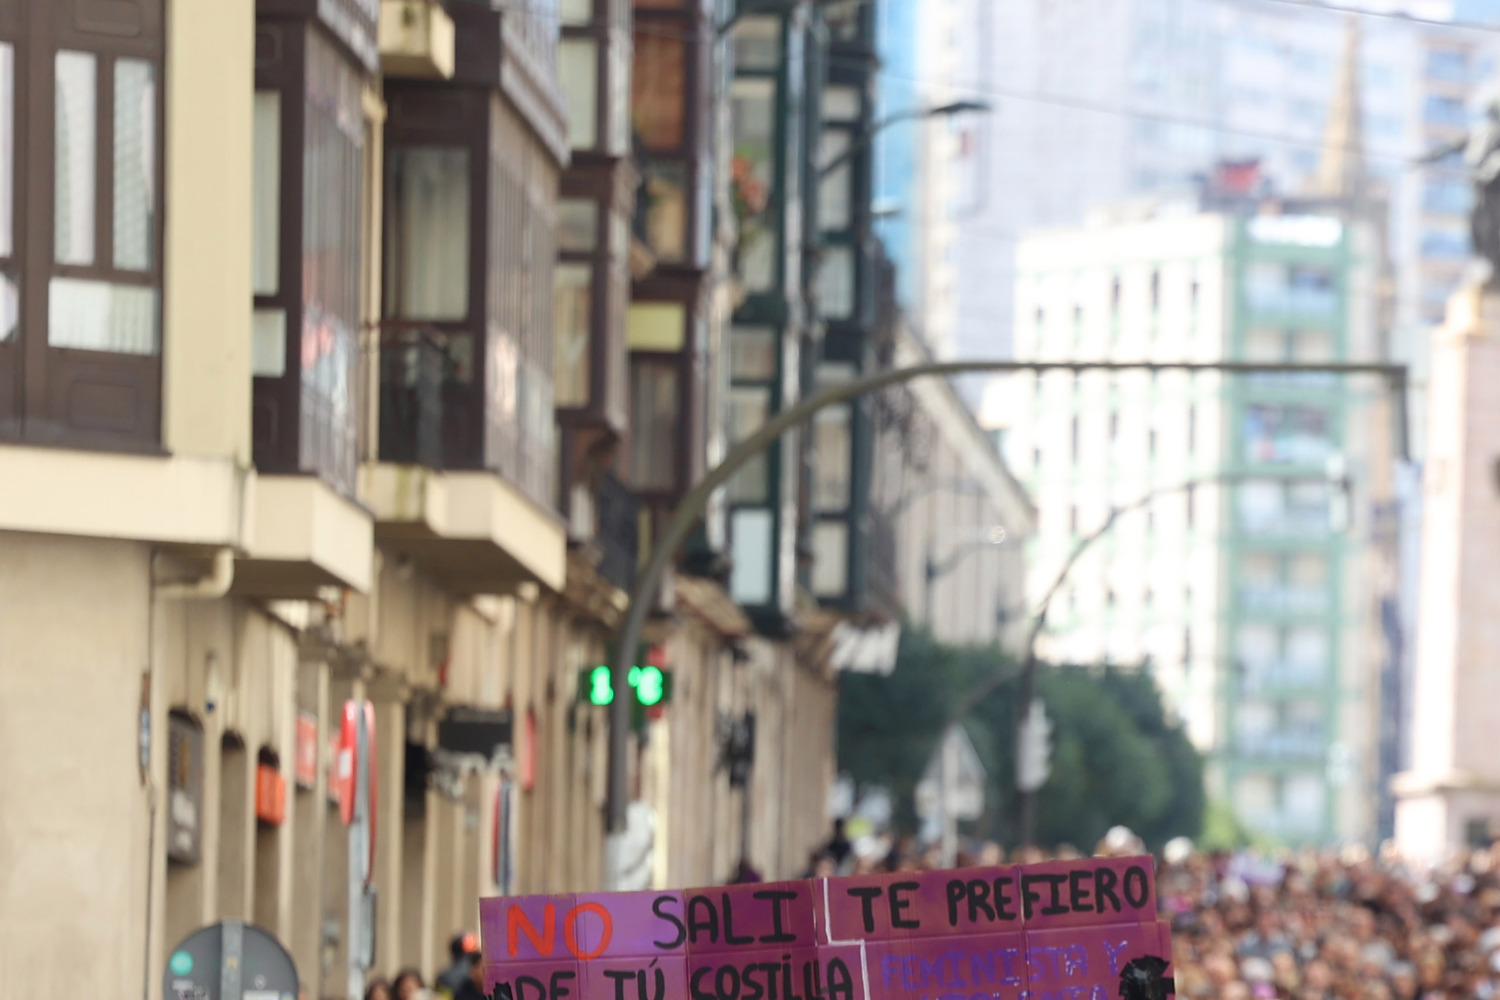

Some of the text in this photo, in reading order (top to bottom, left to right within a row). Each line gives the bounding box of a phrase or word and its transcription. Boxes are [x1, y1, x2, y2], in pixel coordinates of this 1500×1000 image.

[507, 891, 798, 962] NO SALI
[847, 865, 1149, 933] TE PREFIERO
[880, 939, 1129, 991] FEMINISTA Y
